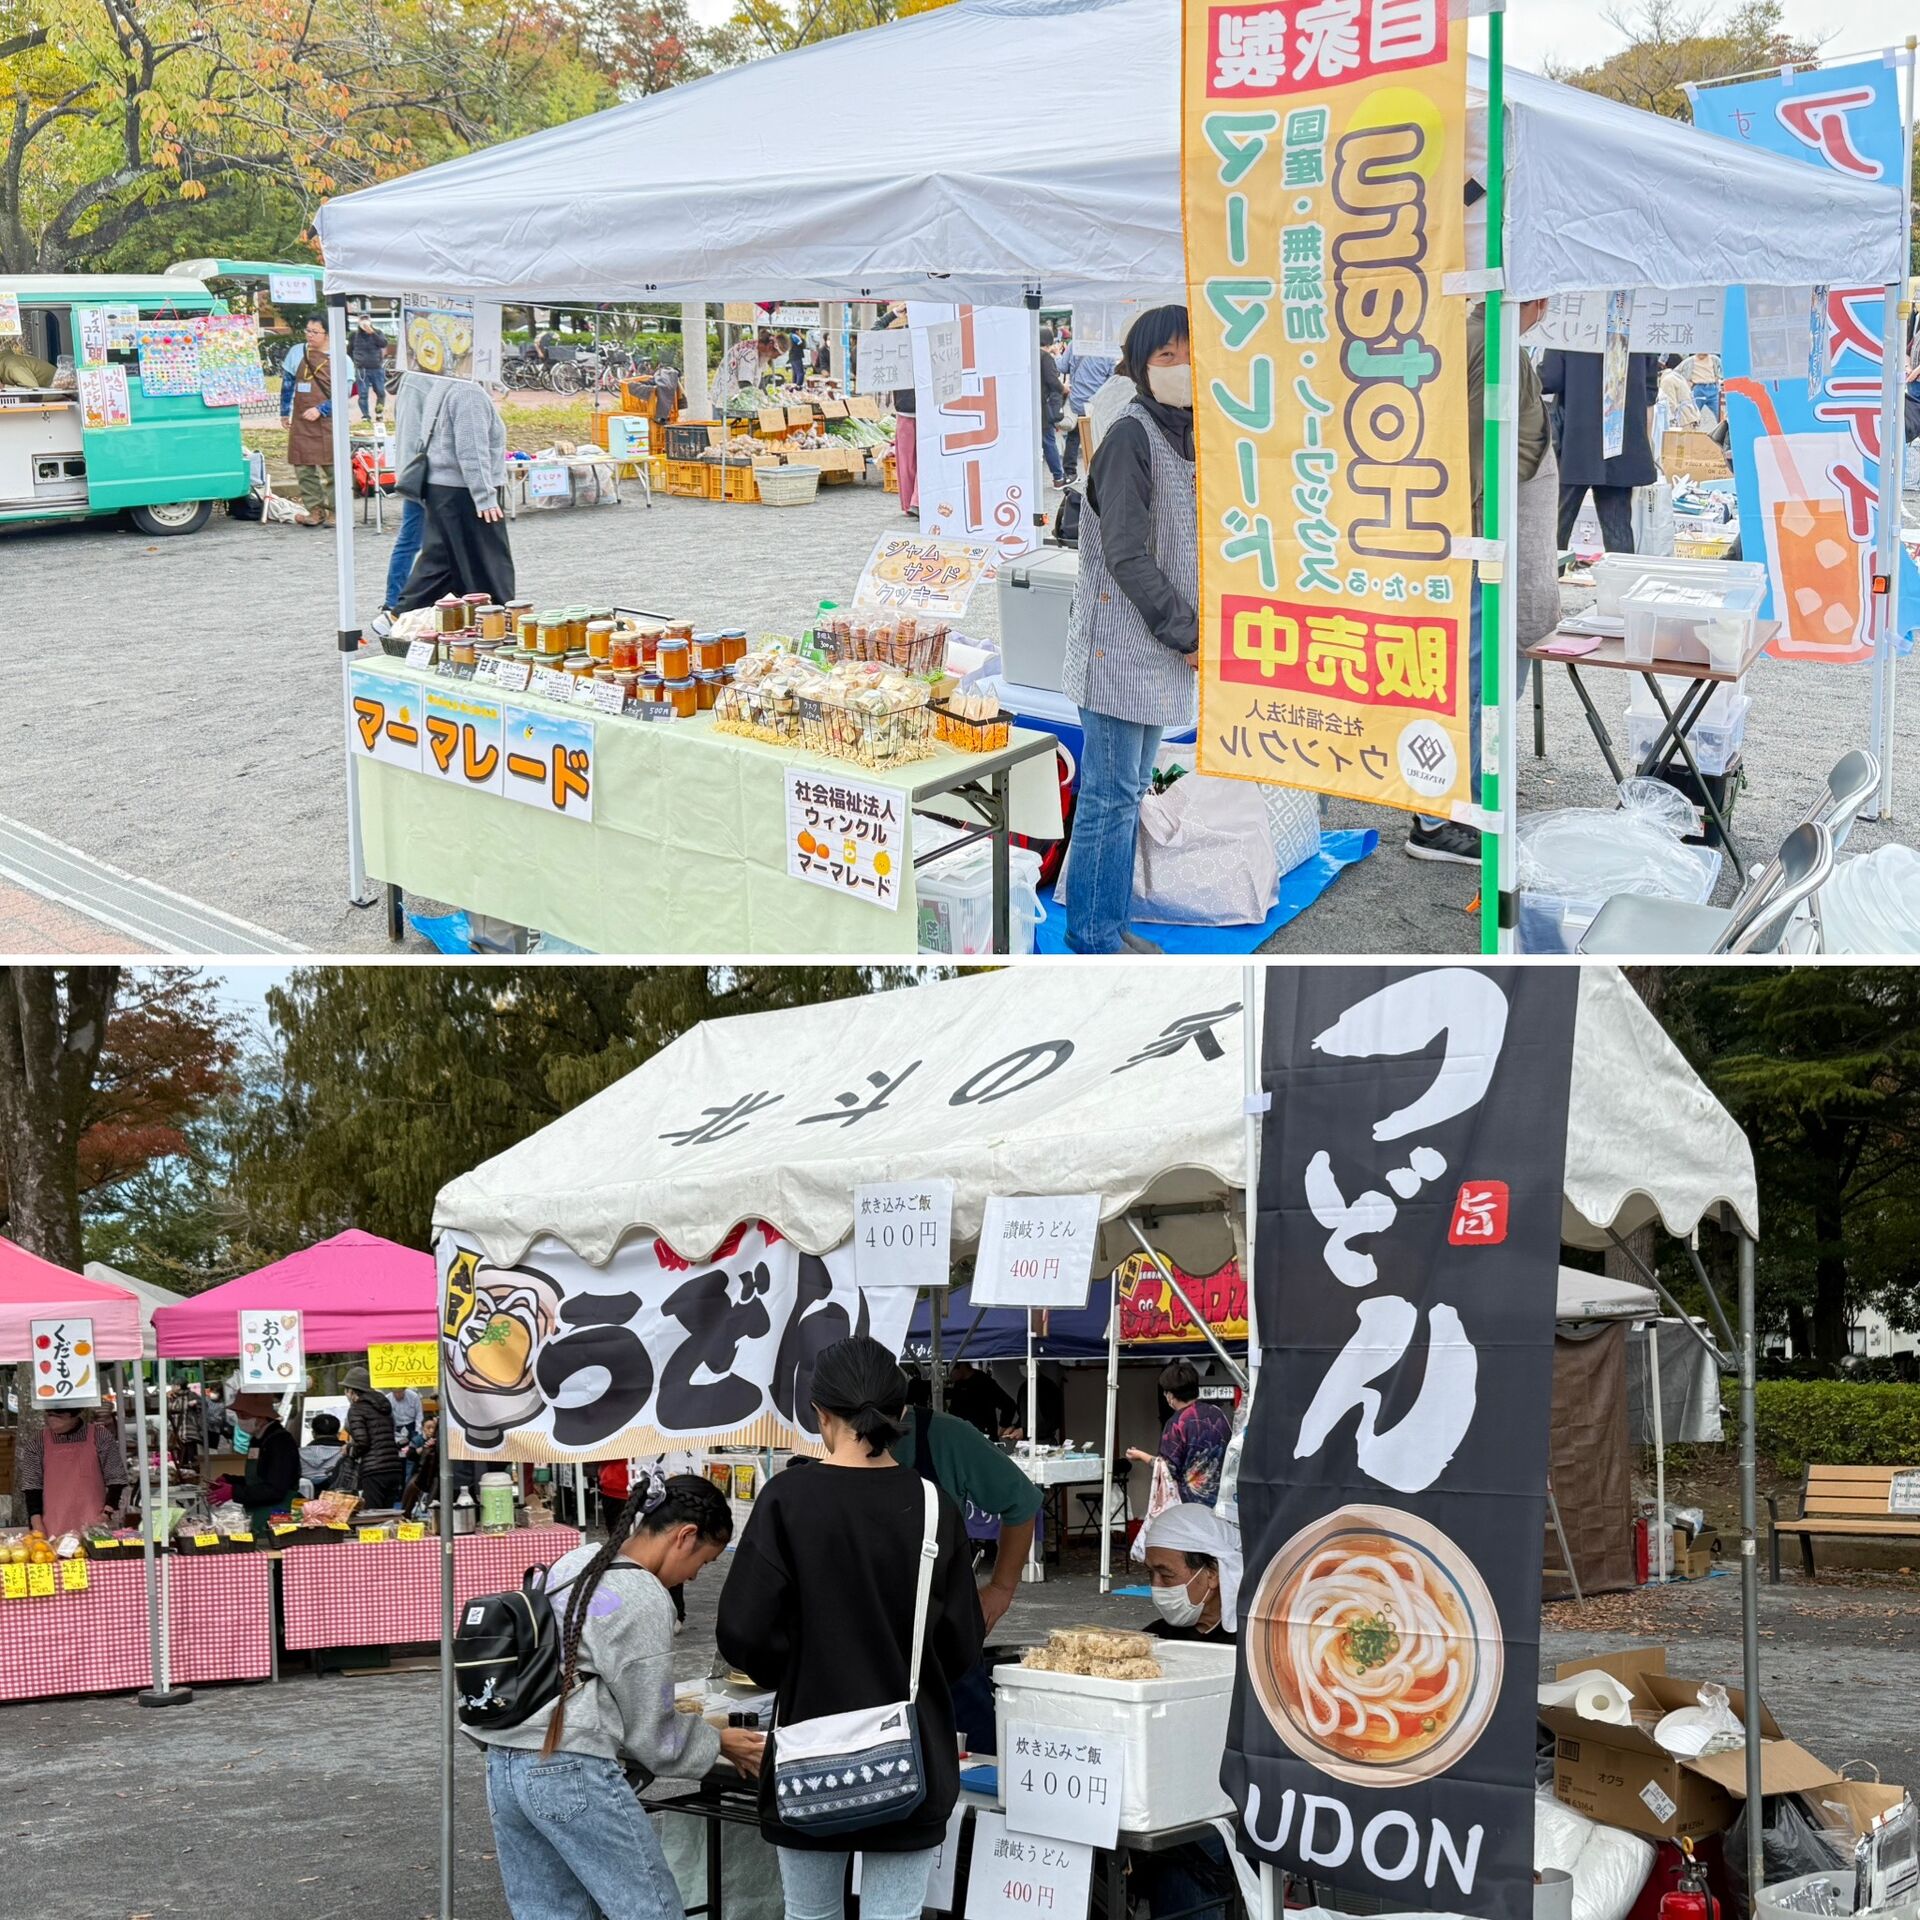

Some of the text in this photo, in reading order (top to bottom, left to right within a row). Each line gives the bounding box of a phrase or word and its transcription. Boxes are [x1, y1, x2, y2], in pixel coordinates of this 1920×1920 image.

[885, 541, 940, 561] ジャム
[903, 562, 961, 583] サンド
[875, 585, 949, 606] クッキー
[479, 657, 500, 675] 甘夏
[353, 696, 590, 811] マーマレード
[795, 780, 896, 824] 社会福祉法人
[805, 806, 887, 846] ウィンクル
[797, 853, 892, 897] マーマレード
[860, 1194, 932, 1215] 炊き込みご飯
[865, 1221, 937, 1248] 400円
[1003, 1220, 1077, 1240] 讃岐うどん
[1009, 1258, 1060, 1280] 400円
[261, 1318, 281, 1372] おかし
[537, 1261, 870, 1446] うどん
[53, 1323, 74, 1397] くだもの
[375, 1356, 436, 1372] おためし
[1015, 1737, 1102, 1766] 炊き込みご飯
[1020, 1768, 1108, 1806] 400円
[1598, 1773, 1624, 1787] オクラ
[1244, 1783, 1484, 1894] UDON
[993, 1838, 1071, 1869] 讃岐うどん
[1002, 1880, 1055, 1909] 400円
